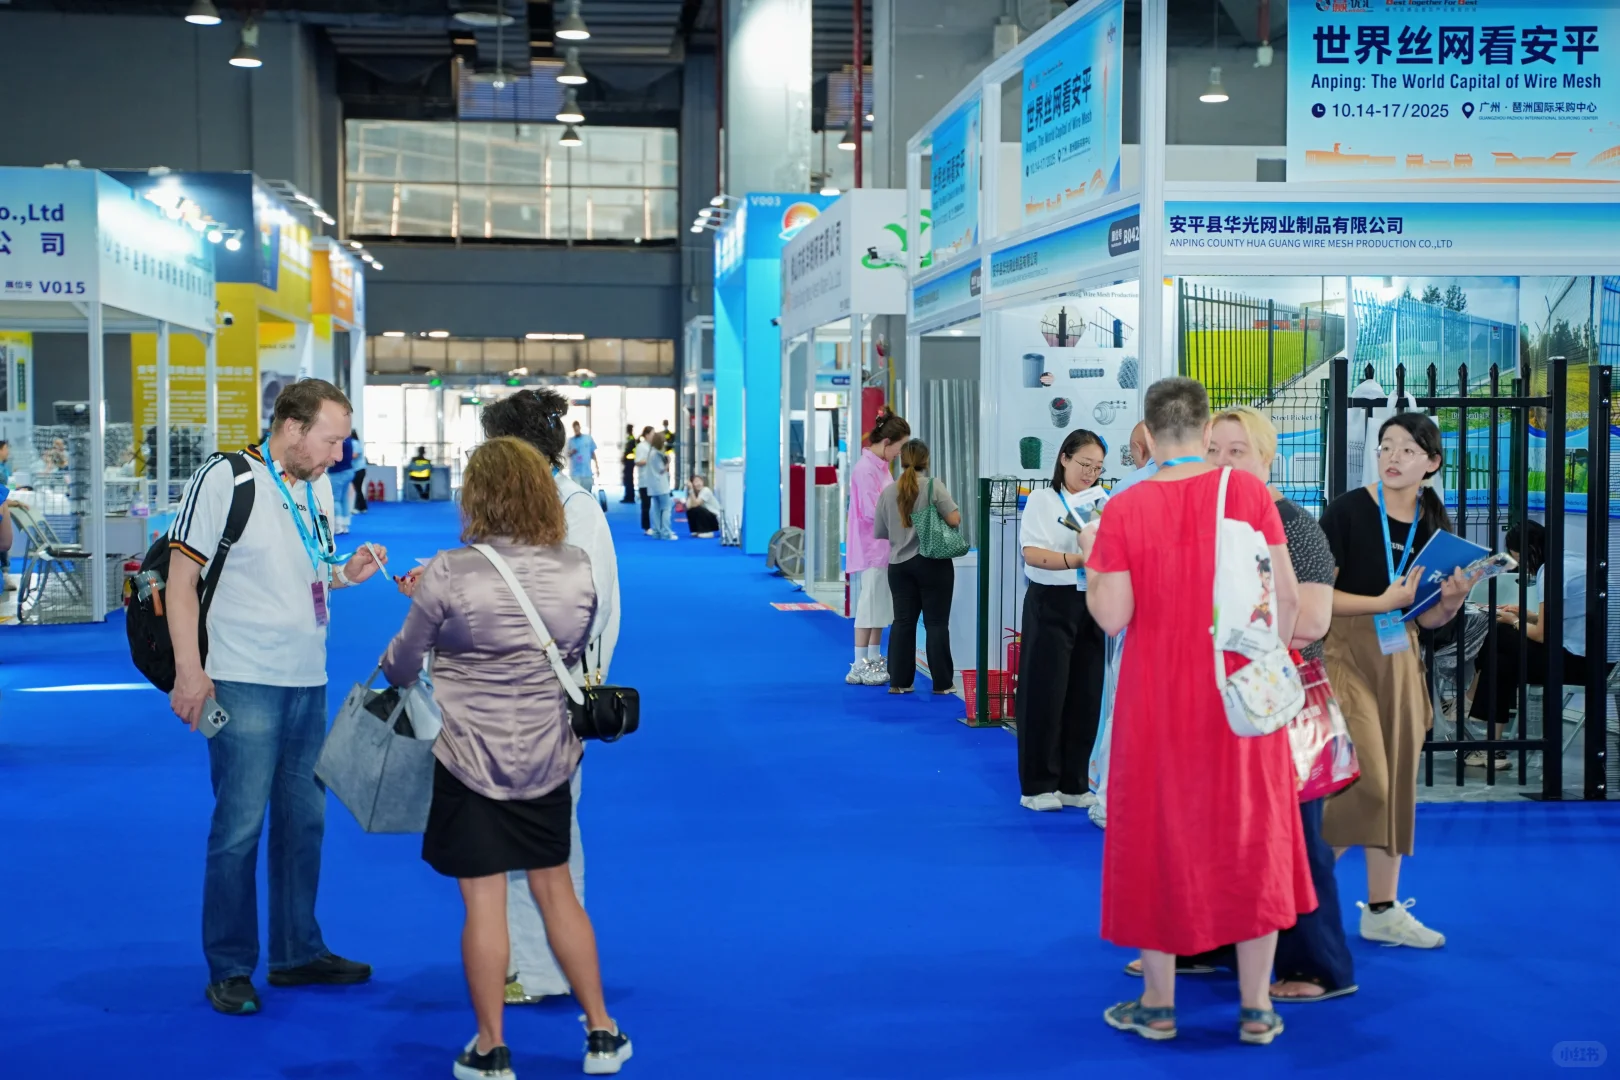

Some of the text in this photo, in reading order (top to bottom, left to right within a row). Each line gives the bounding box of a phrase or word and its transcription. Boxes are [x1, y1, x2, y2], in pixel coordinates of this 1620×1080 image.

[1312, 24, 1599, 65] 世界丝网看安平
[1311, 73, 1601, 92] Anping: The World Capital of Wire Mesh
[1026, 66, 1092, 133] 世界丝网看安平
[1332, 103, 1449, 118] 10.14-17/2025
[750, 195, 781, 207] V003
[1169, 215, 1403, 234] 安平县华光网业制品有限公司
[1169, 238, 1453, 249] ANPING COUNTY HUA GUANG WIRE MESH PRODUCTION CO.,LTD
[39, 281, 86, 295] V015
